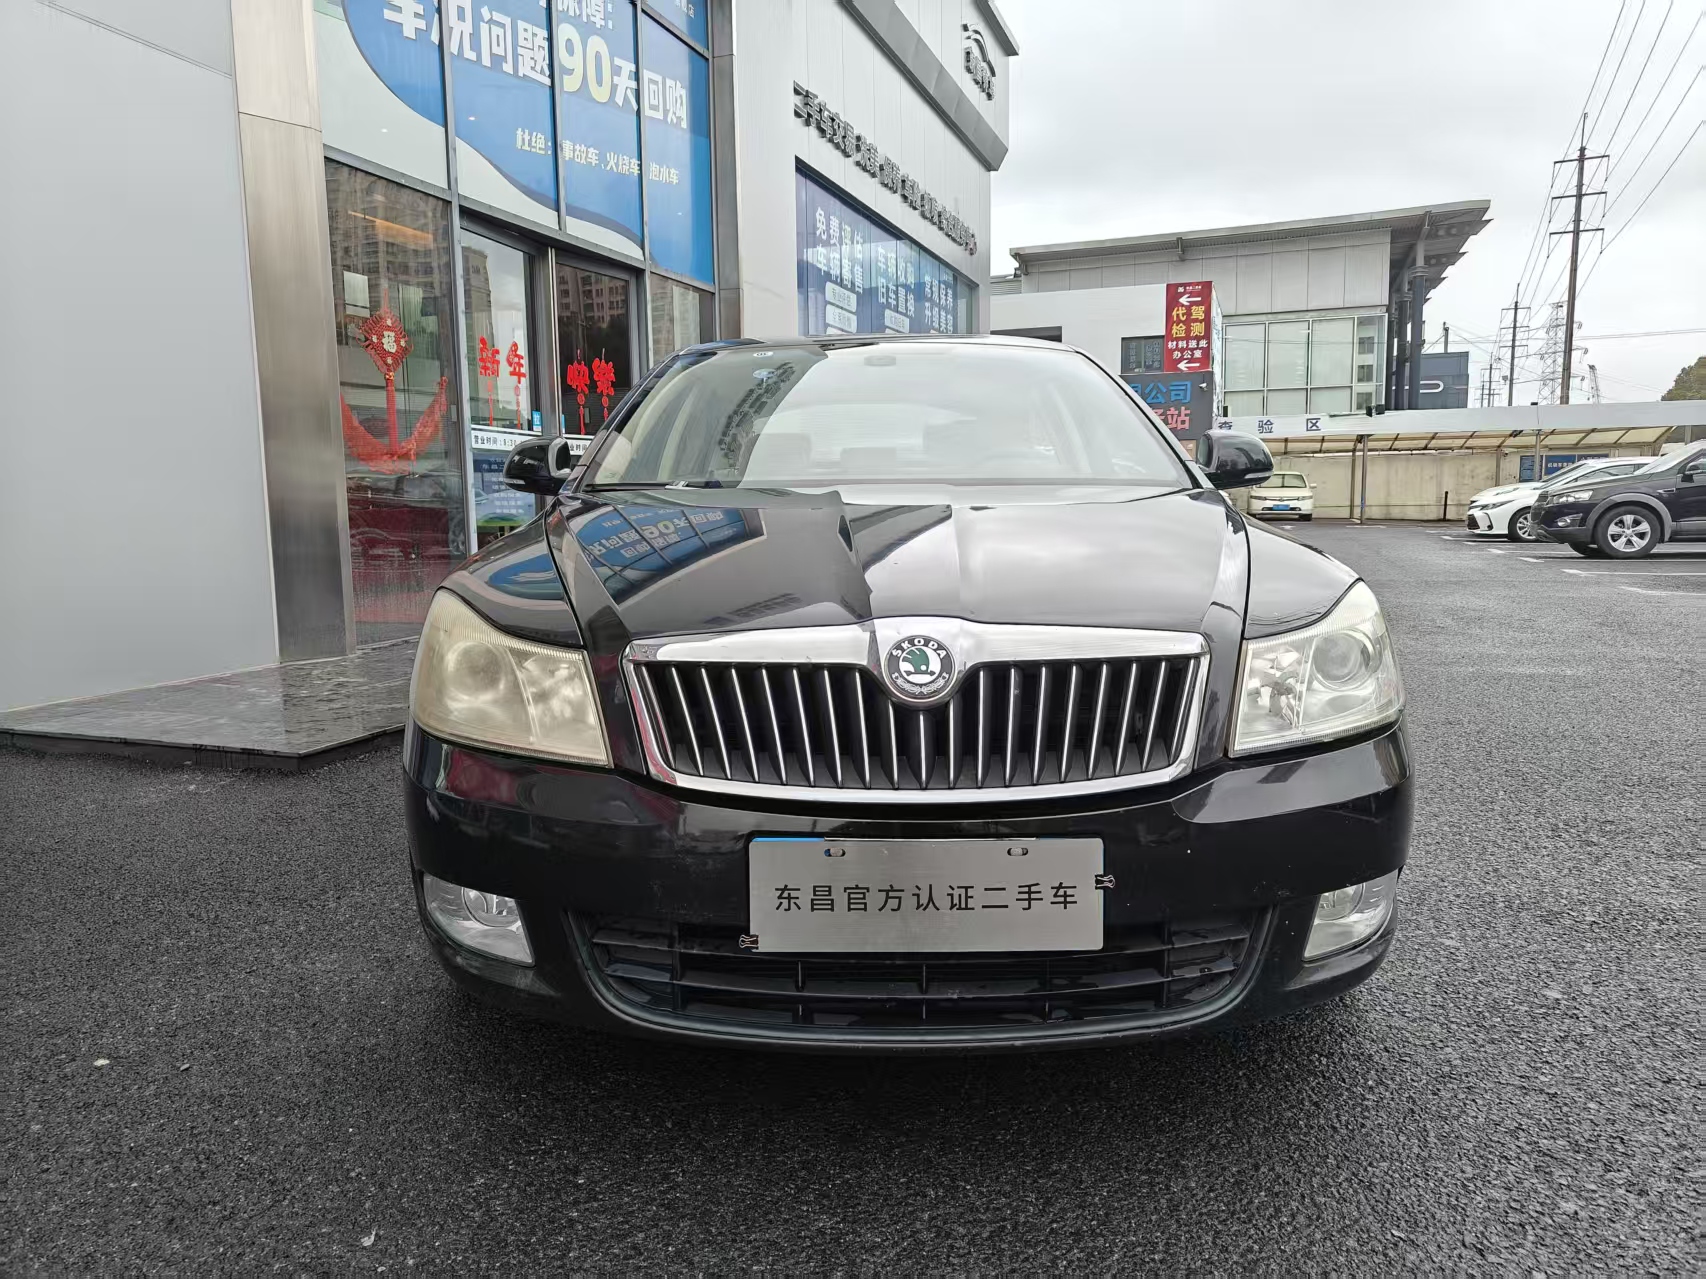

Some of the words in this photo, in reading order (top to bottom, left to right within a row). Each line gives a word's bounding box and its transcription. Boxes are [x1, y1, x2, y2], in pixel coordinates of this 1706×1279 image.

[1172, 306, 1205, 321] 代驾
[1172, 322, 1205, 338] 检测
[1168, 340, 1208, 349] 材料送此
[1173, 350, 1202, 359] 办公室
[774, 882, 1078, 912] 东昌官方认证二手车
